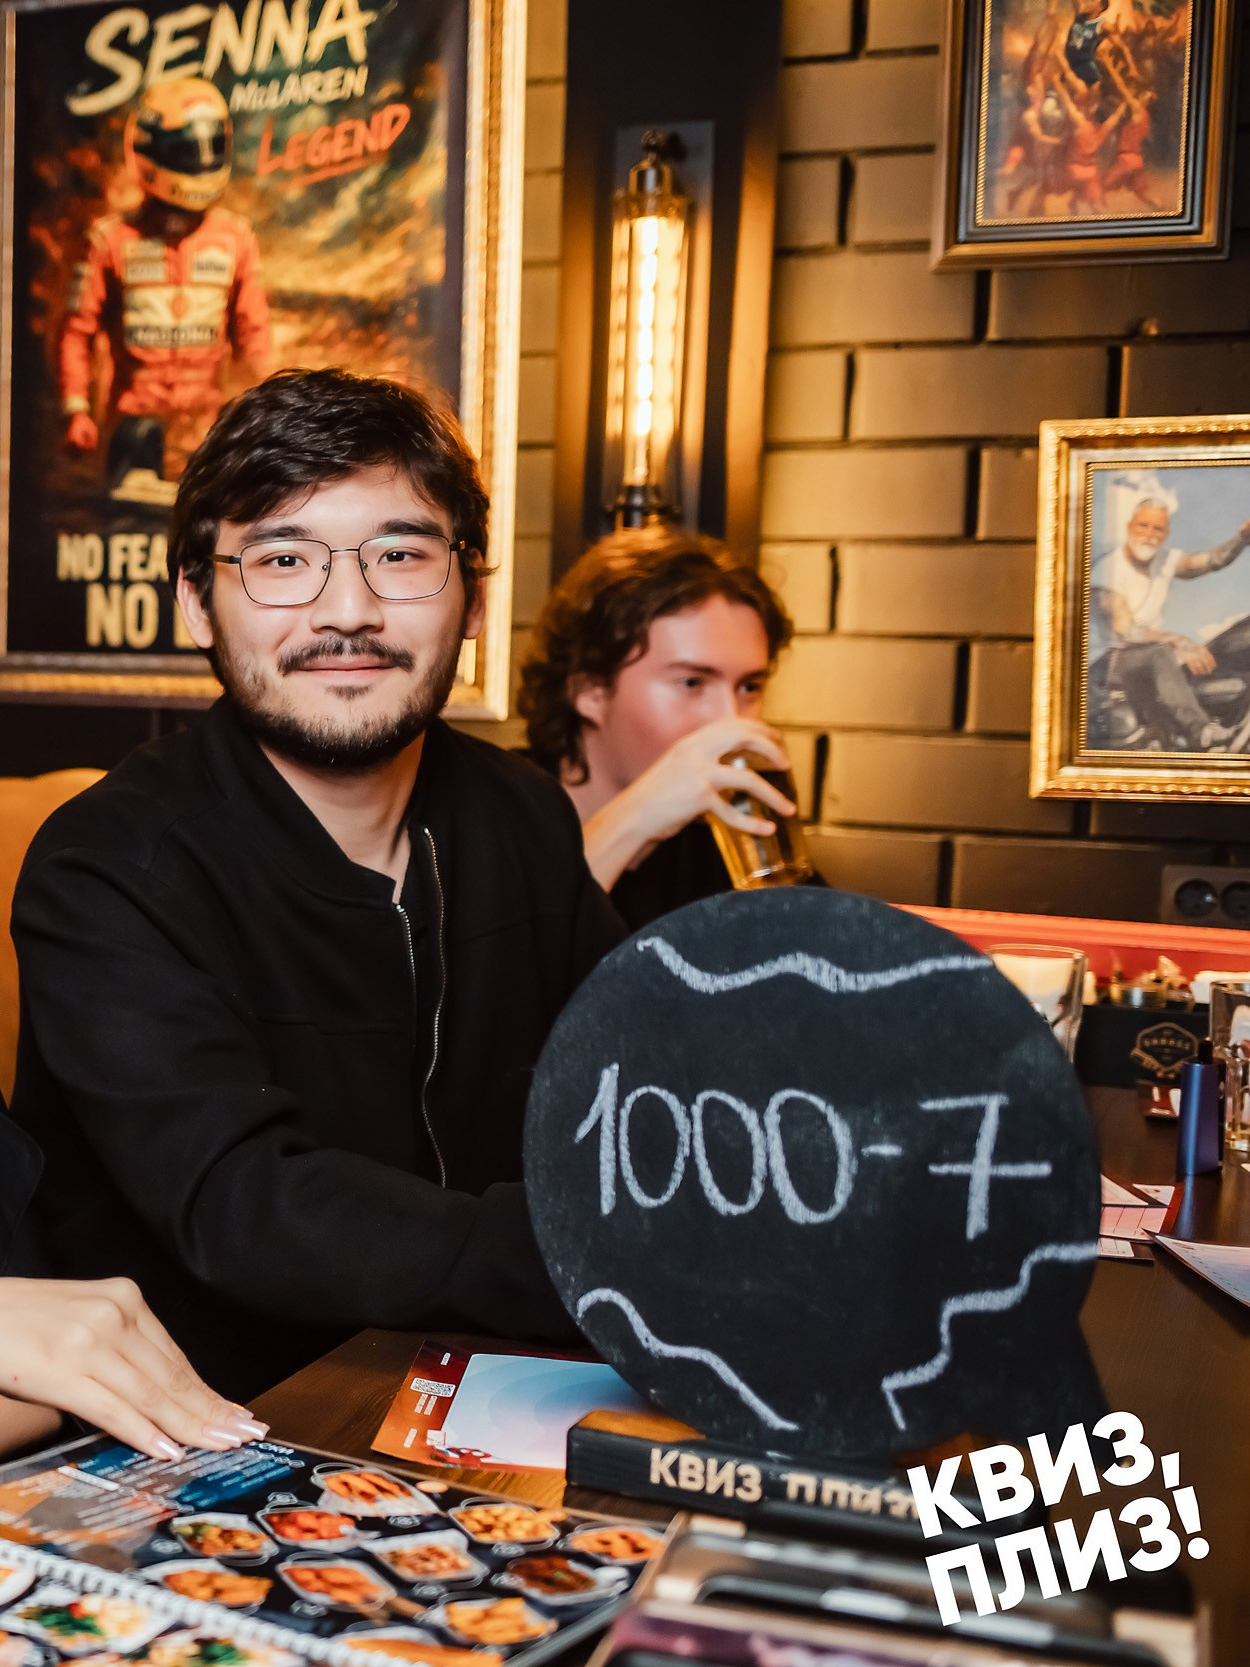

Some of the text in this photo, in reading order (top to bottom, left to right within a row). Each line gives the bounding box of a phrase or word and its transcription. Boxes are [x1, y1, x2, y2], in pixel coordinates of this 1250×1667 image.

[65, 0, 378, 117] SENNA
[256, 103, 412, 178] LEGEND
[56, 532, 170, 582] NO FEA
[85, 581, 160, 650] NO
[649, 1447, 763, 1503] КВИЗ
